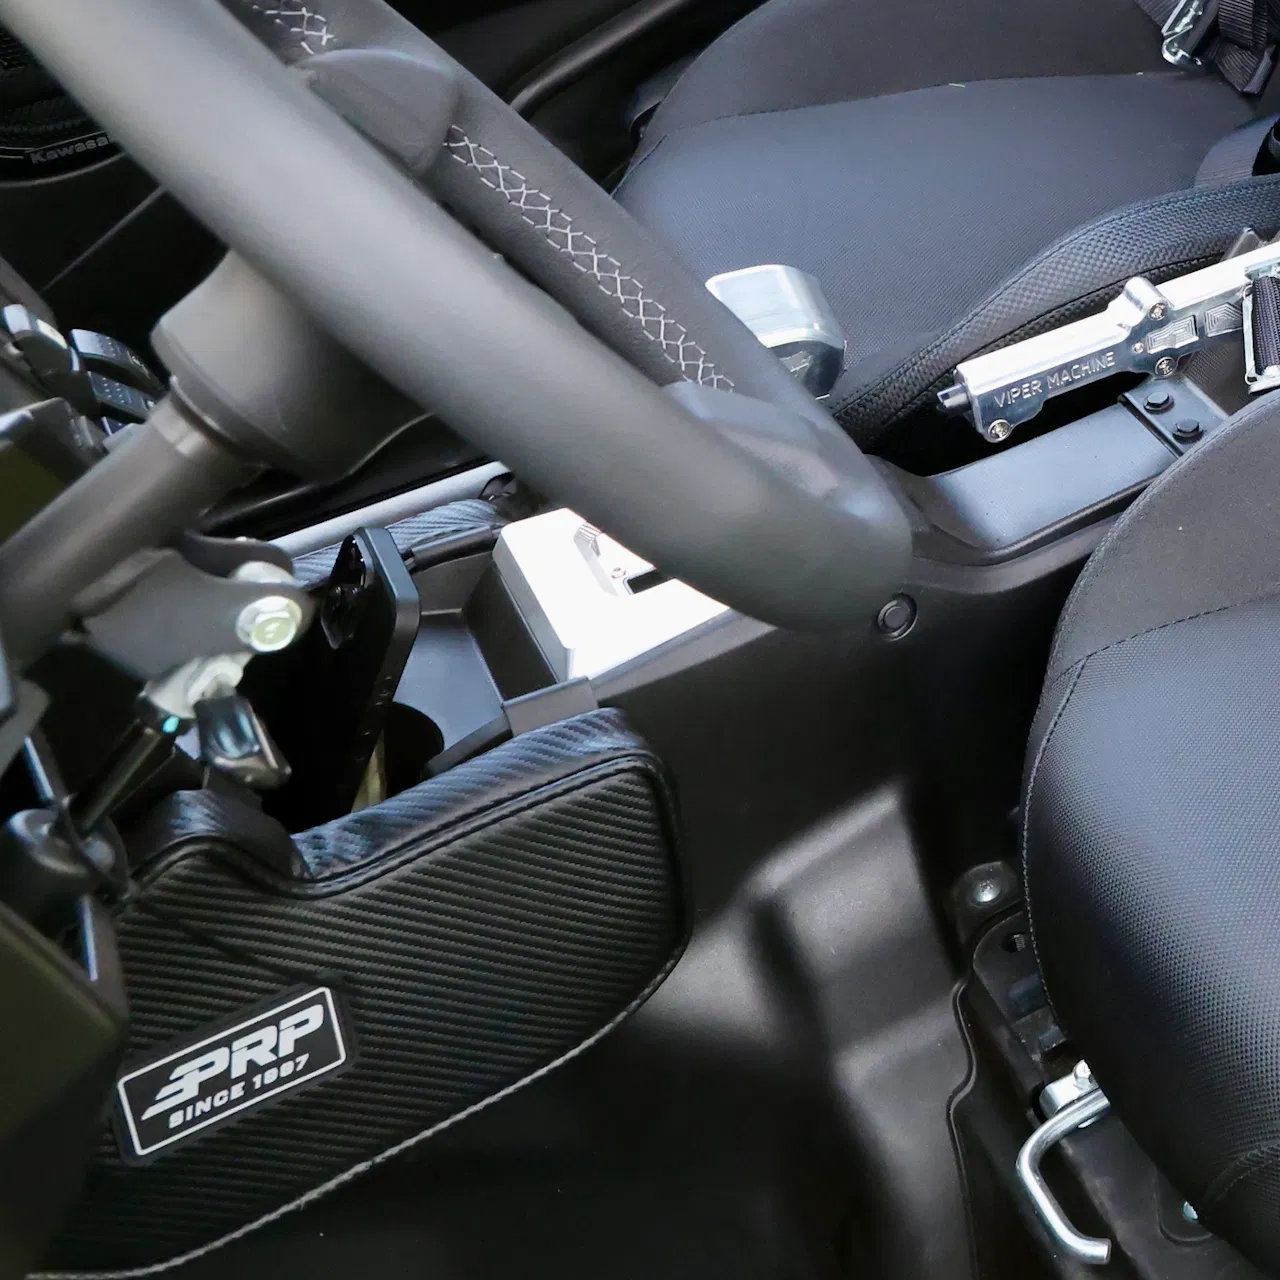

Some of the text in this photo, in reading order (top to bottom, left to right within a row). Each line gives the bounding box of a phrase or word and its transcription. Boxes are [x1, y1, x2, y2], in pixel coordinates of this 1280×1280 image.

[30, 137, 109, 164] Kawasa
[994, 352, 1115, 408] VIPER MACHINE
[141, 1004, 324, 1120] PRP
[169, 1082, 246, 1129] SINCE
